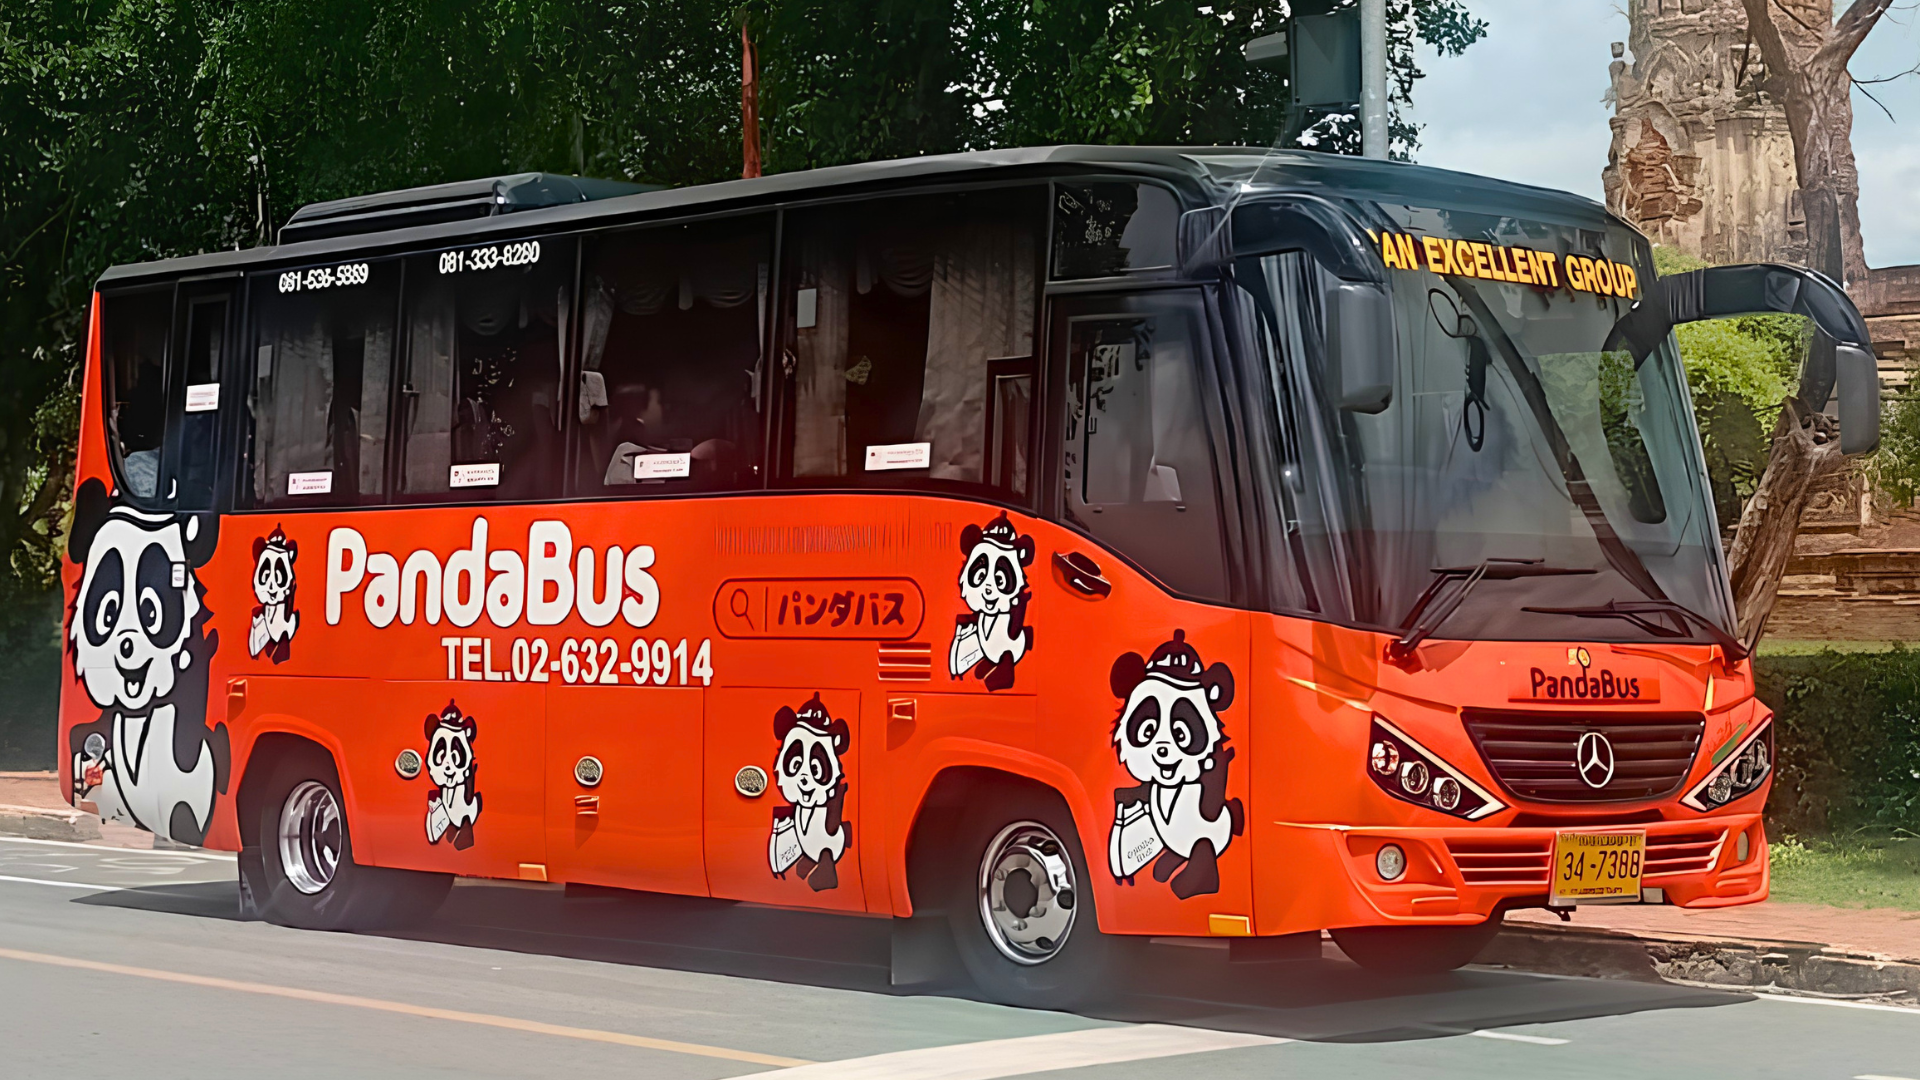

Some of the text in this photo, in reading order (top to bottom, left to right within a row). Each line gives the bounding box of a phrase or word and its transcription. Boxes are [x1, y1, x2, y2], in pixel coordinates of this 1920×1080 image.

[1422, 236, 1559, 287] EXCELLENT
[1565, 254, 1637, 299] GROUP
[325, 516, 660, 628] PandaBus
[778, 591, 905, 627] パンダバス
[441, 637, 714, 687] TEL.02-632-9914
[1530, 665, 1640, 698] PandaBus
